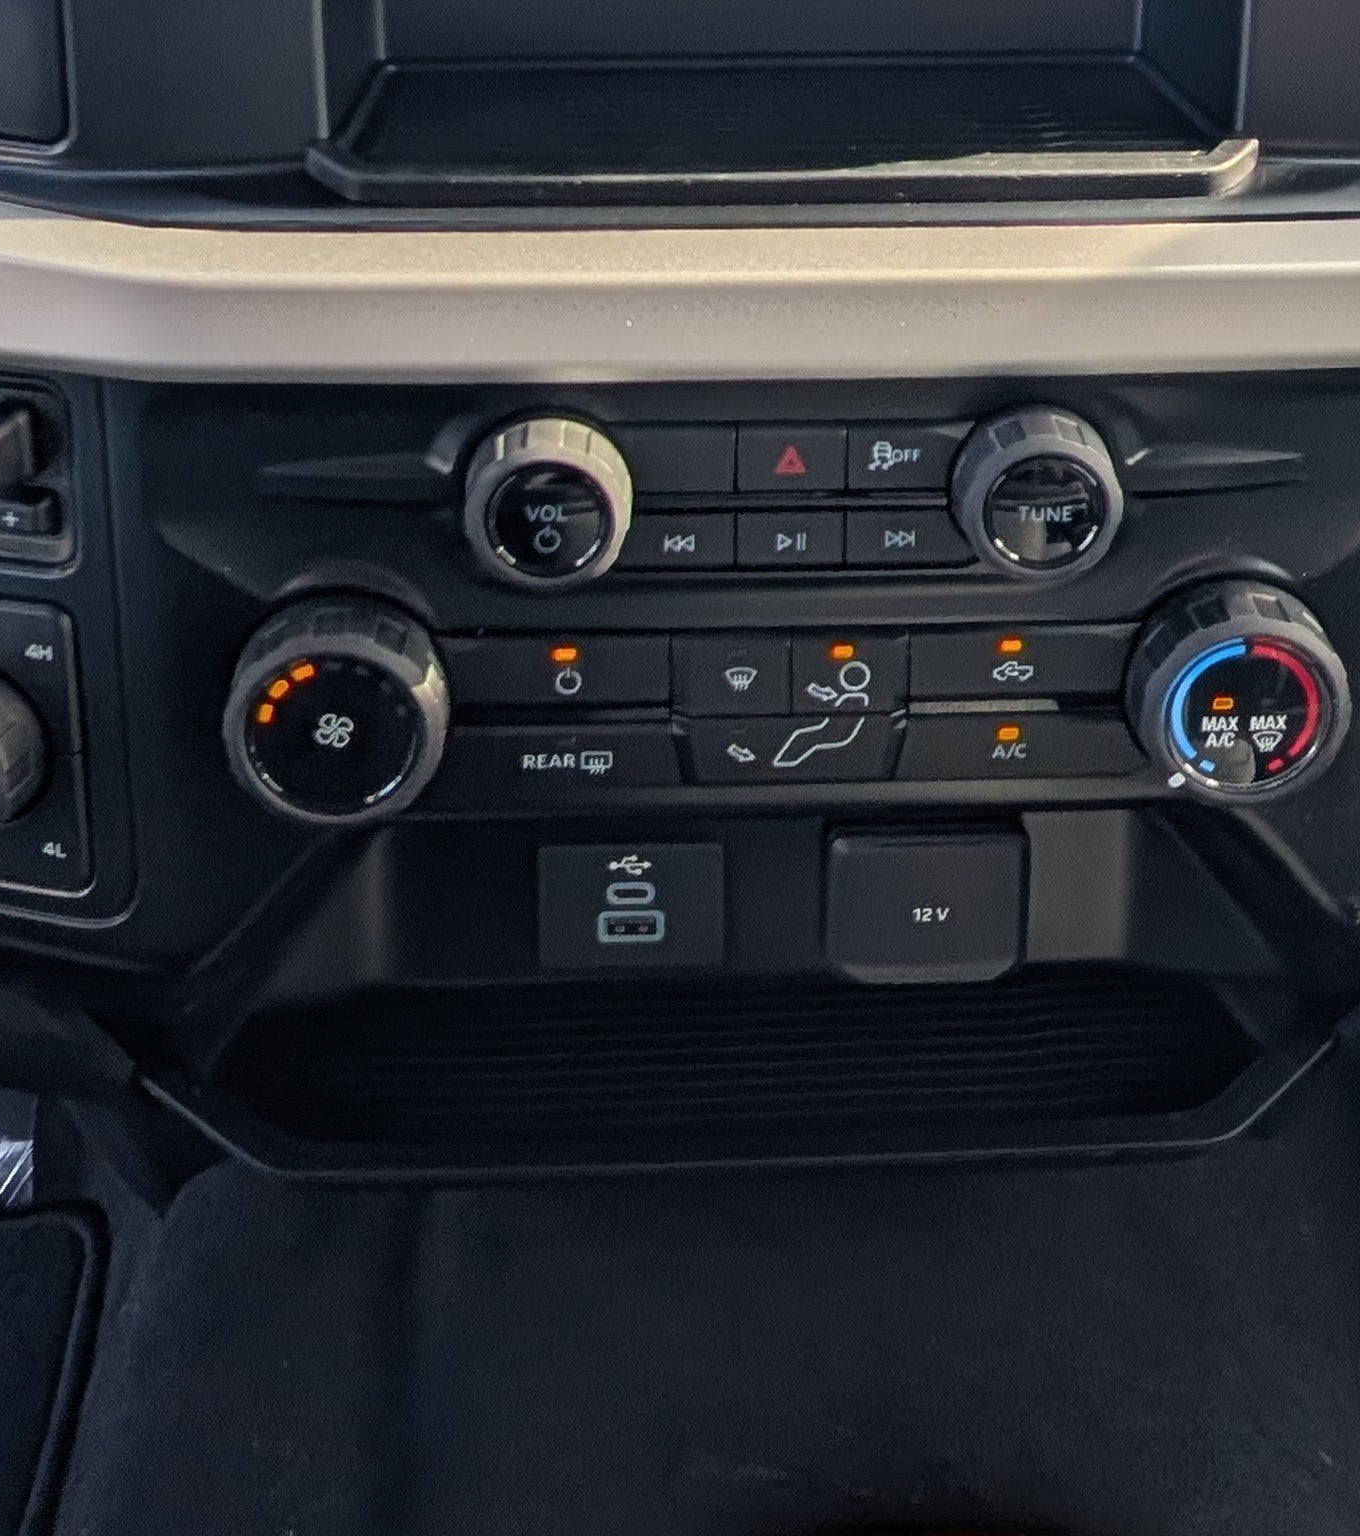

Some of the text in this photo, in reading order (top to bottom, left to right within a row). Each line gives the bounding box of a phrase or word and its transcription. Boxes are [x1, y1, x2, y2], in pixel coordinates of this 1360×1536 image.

[892, 448, 921, 463] OFF
[524, 504, 570, 523] VOL
[1017, 505, 1074, 523] TUNE
[24, 643, 54, 662] 4H
[1201, 715, 1239, 733] MAX
[1248, 714, 1288, 732] MAX
[1204, 731, 1236, 749] A/C
[991, 742, 1028, 760] A/C
[522, 752, 577, 770] REAR
[42, 842, 68, 859] 4L
[912, 907, 950, 922] 12 V
